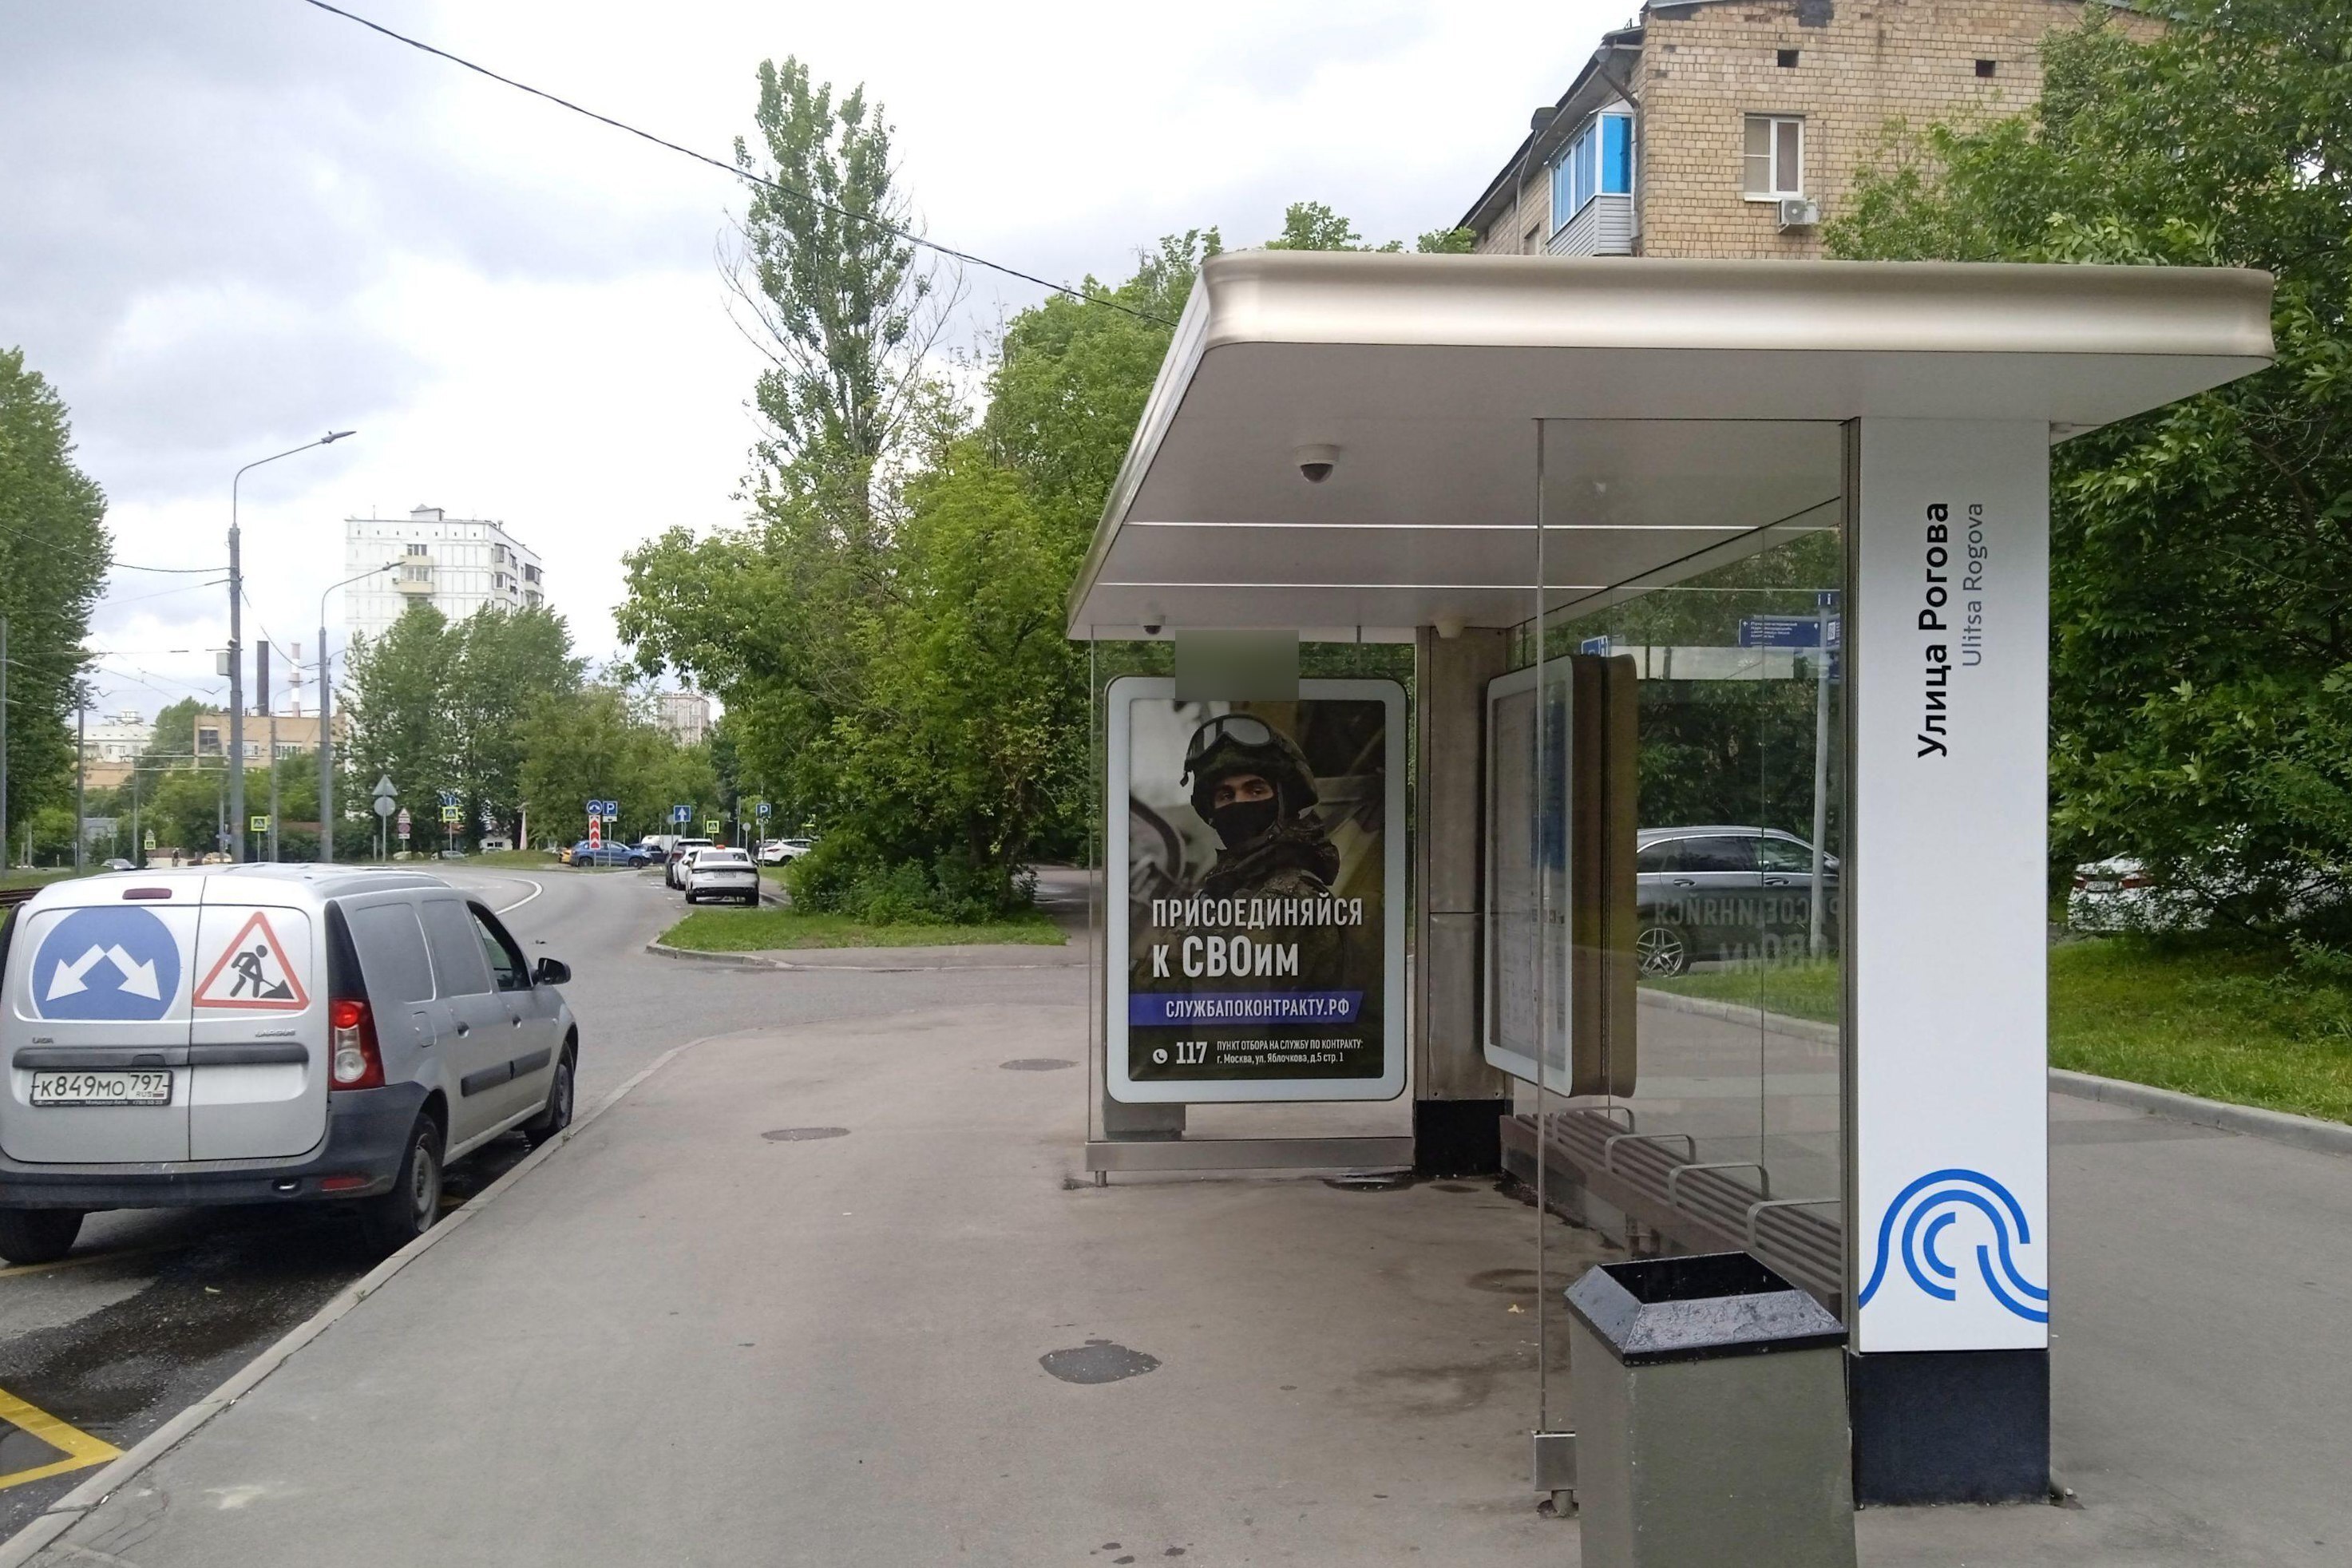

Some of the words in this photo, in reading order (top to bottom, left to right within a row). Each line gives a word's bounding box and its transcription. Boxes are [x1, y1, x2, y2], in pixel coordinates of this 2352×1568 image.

[1961, 504, 1988, 592] Rogova
[1917, 503, 1950, 631] Рогова
[1961, 600, 1982, 667] Ulitsa
[1917, 644, 1952, 758] Улица
[1153, 893, 1363, 930] ПРИСОЕДИНЯЙСЯ
[1166, 999, 1350, 1018] СЛУЖБАПОКОНТРАКТУ.РФ
[1175, 1041, 1208, 1065] 117
[1217, 1040, 1240, 1051] ПУНКТ
[1241, 1039, 1269, 1051] ОТБОРА
[1269, 1039, 1279, 1051] НА
[1280, 1039, 1309, 1050] СЛУЖБУ
[1309, 1039, 1321, 1050] ПО
[1217, 1055, 1223, 1064] г.
[1224, 1053, 1255, 1065] Москва,
[1255, 1055, 1267, 1065] ул.
[1267, 1052, 1309, 1064] Яблочкова,
[1323, 1054, 1339, 1064] стр.
[1340, 1051, 1344, 1063] 1
[40, 1074, 125, 1097] К849МО
[130, 1074, 164, 1091] 797
